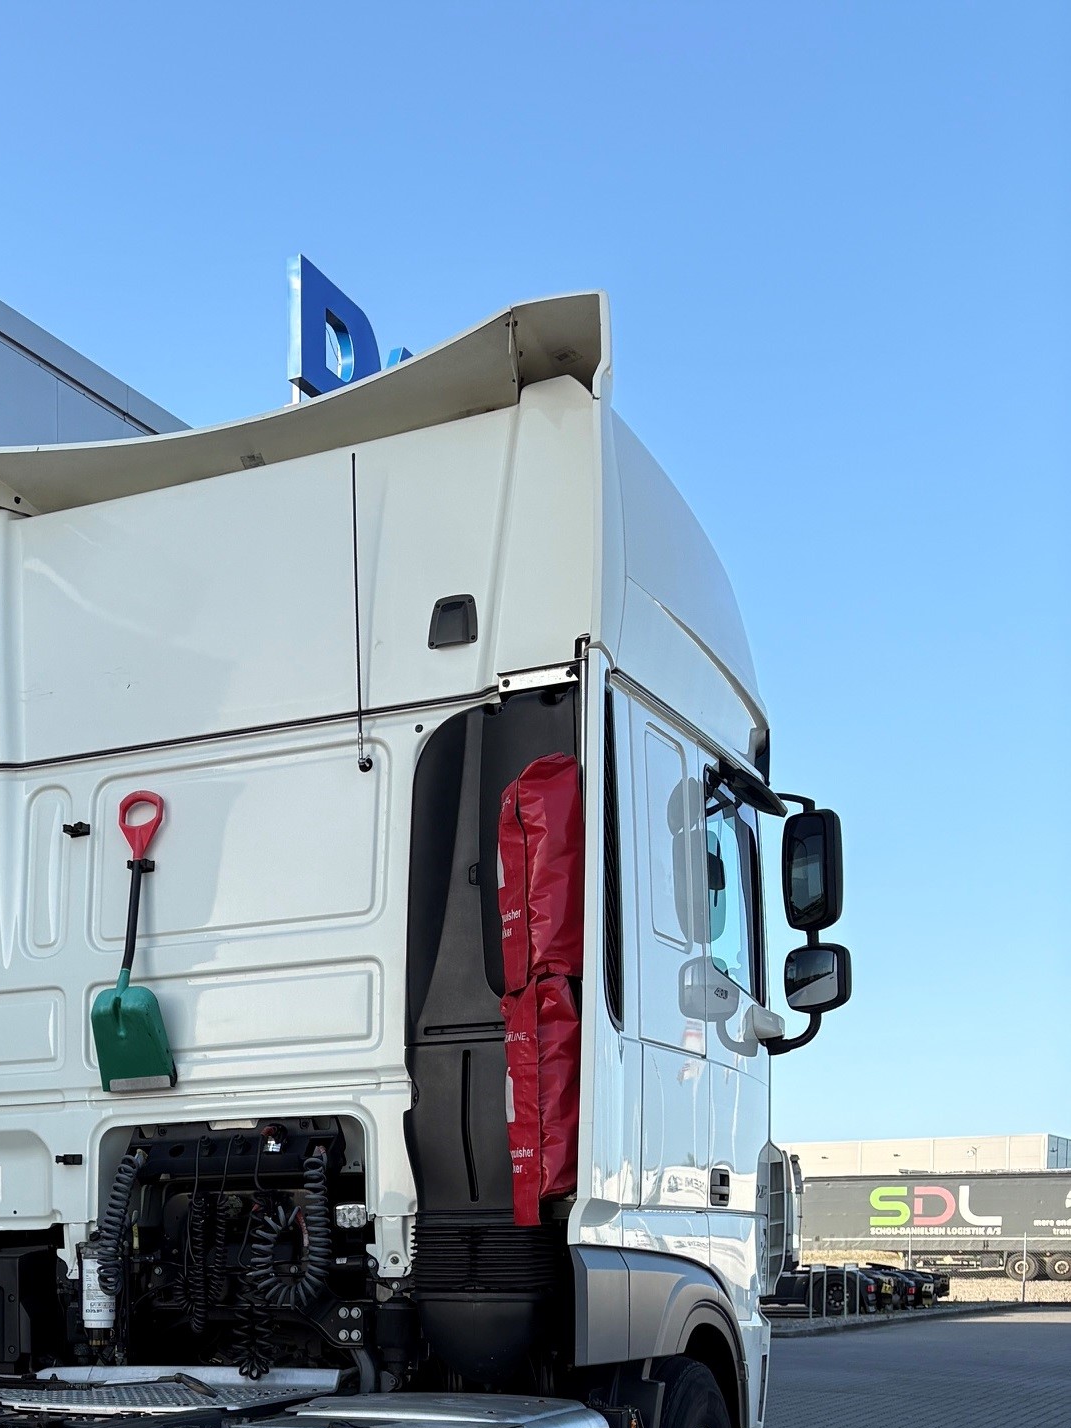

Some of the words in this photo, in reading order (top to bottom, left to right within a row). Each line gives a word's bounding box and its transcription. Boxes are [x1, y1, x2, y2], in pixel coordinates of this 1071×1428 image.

[870, 1185, 1003, 1226] SDL
[946, 1226, 986, 1236] LOGISTIK
[986, 1226, 1002, 1236] A/S
